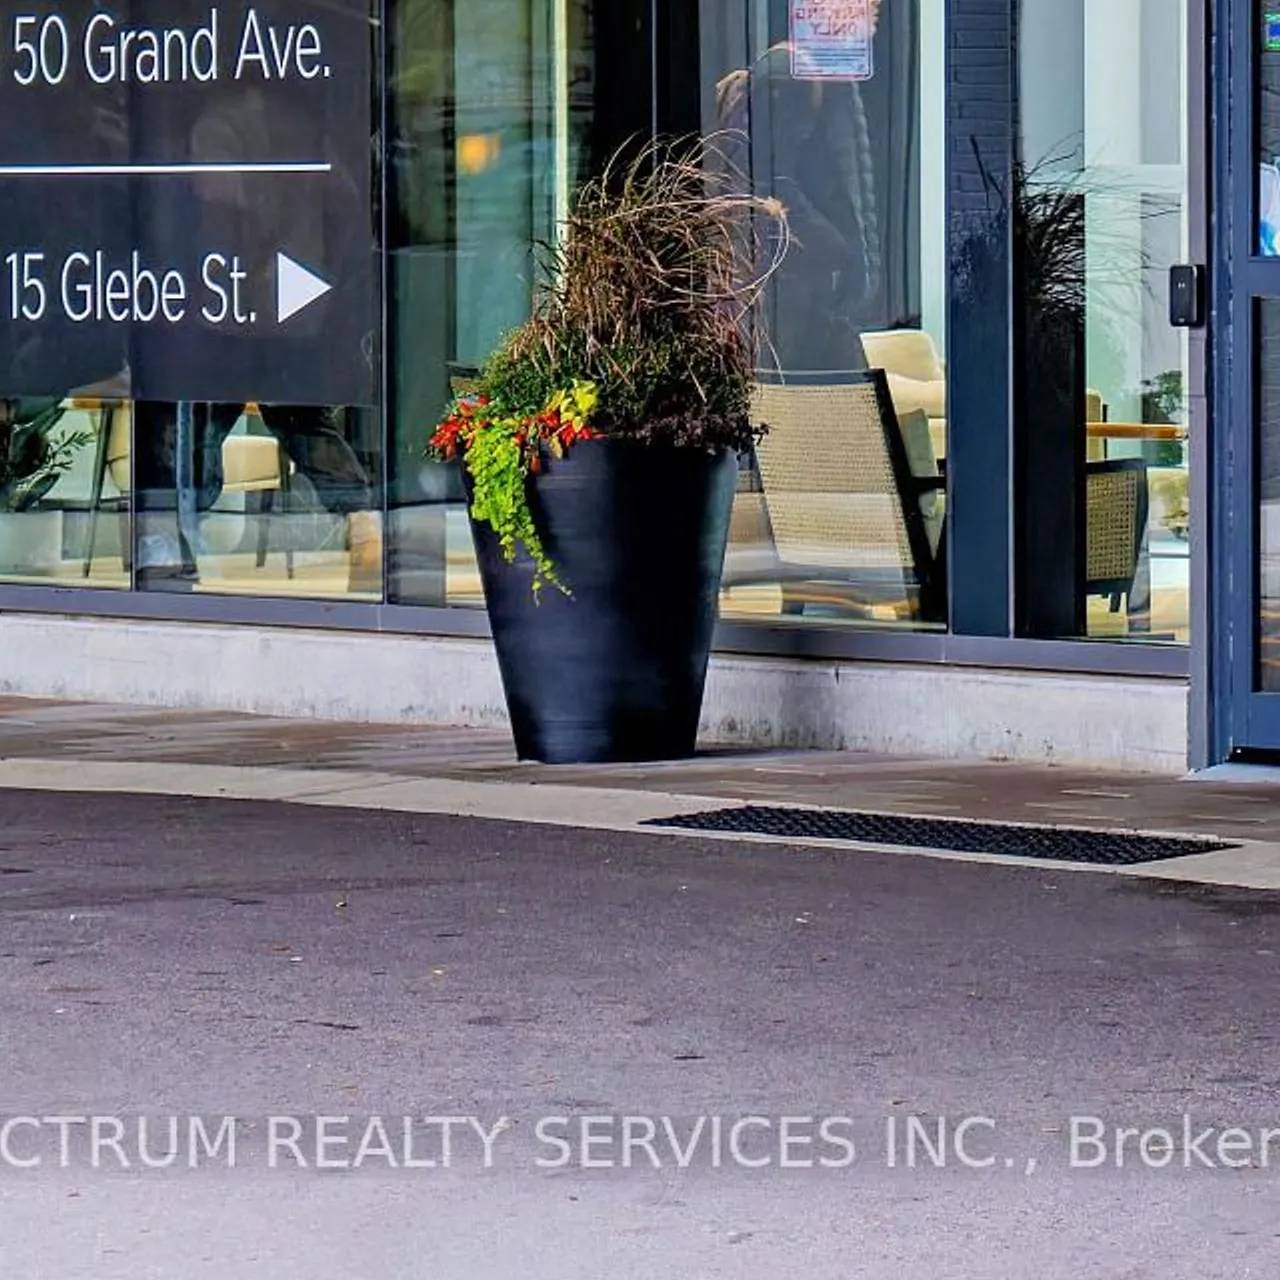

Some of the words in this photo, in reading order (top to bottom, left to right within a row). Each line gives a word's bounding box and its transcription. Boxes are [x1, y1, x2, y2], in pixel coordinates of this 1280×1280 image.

[12, 14, 69, 86] 50
[83, 7, 218, 84] Grand
[234, 7, 331, 81] Ave.
[5, 252, 47, 321] 15
[60, 250, 186, 323] Glebe
[200, 253, 258, 323] St.
